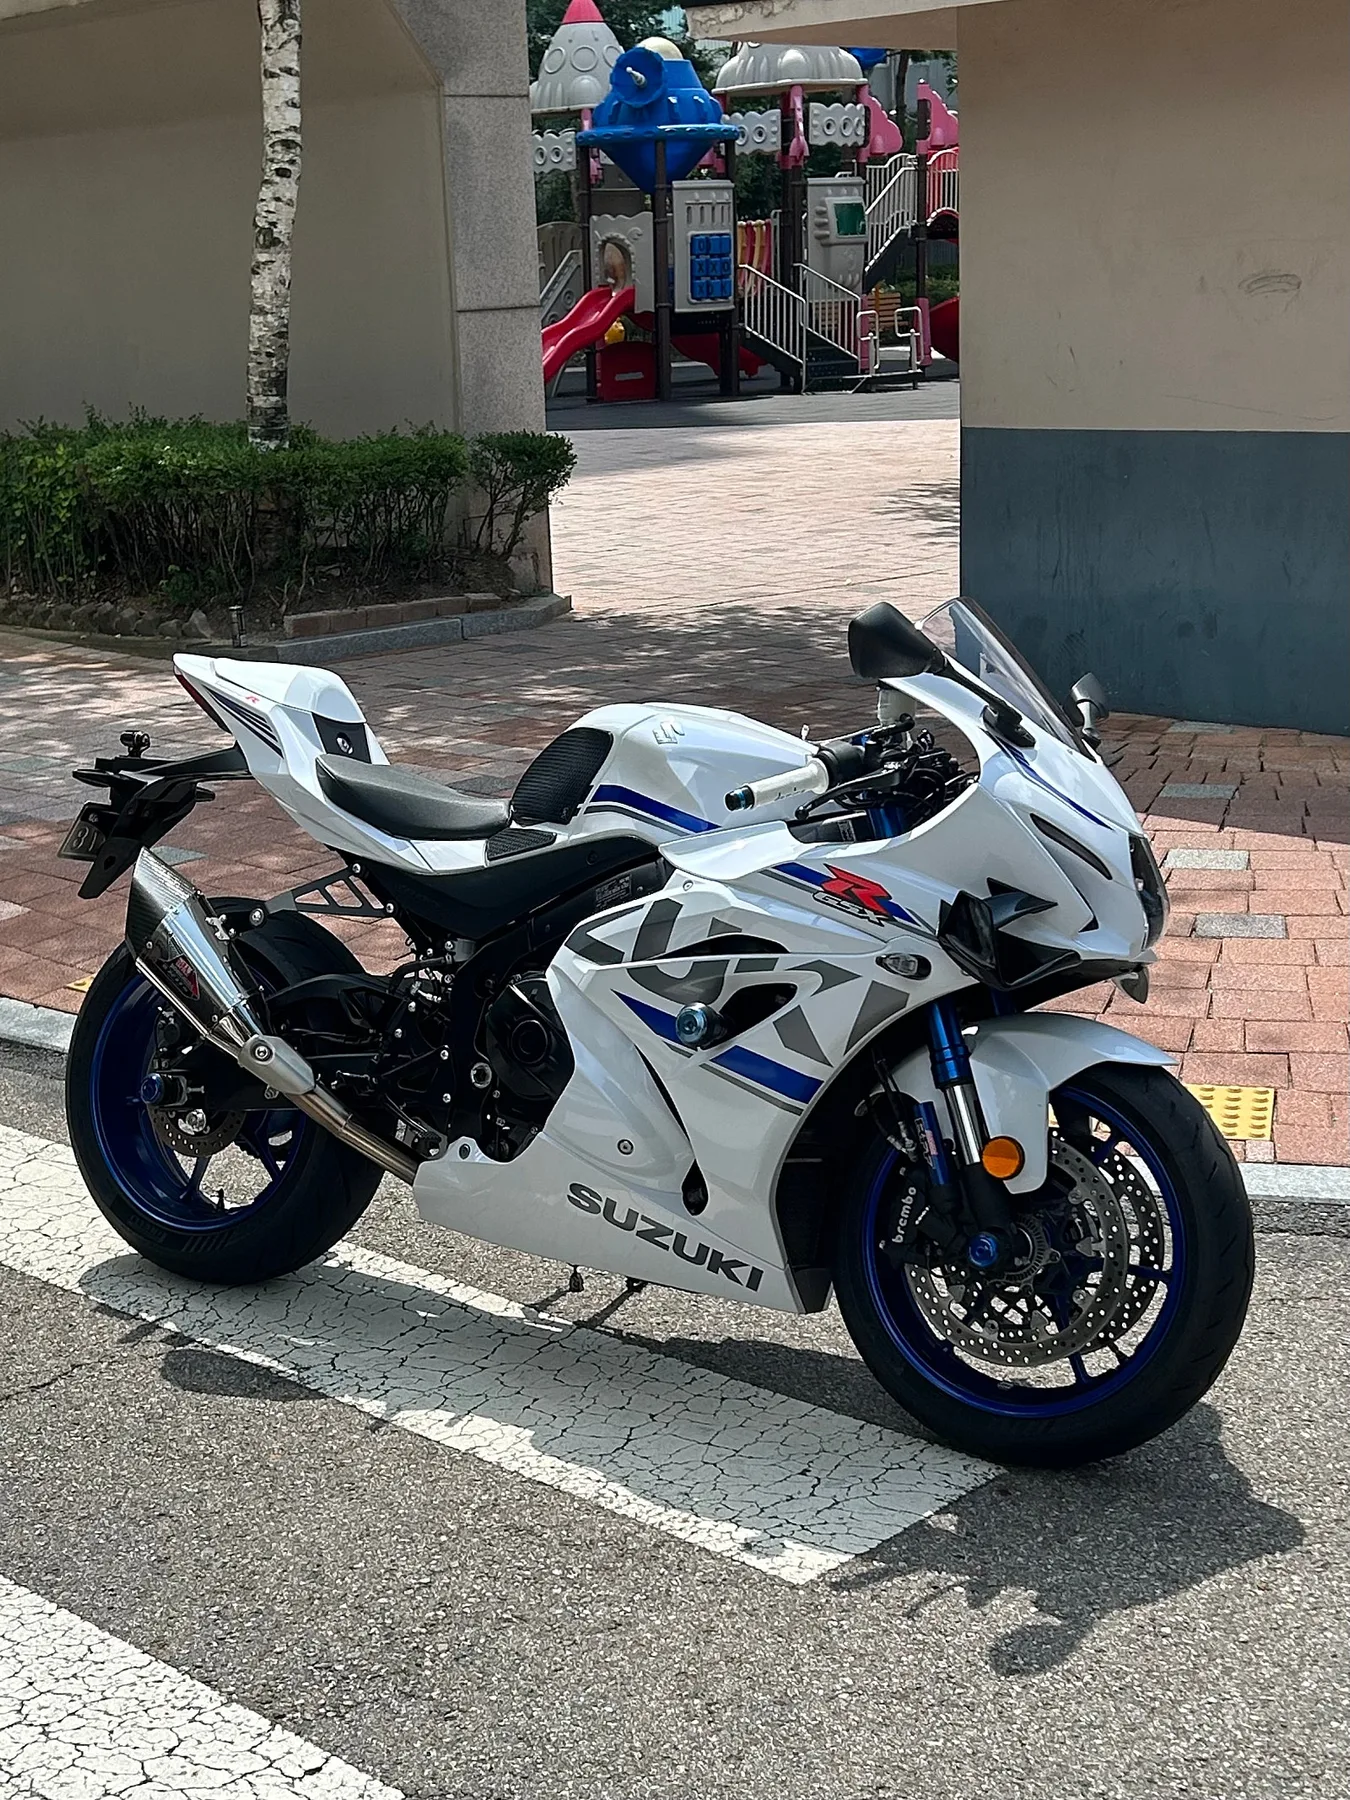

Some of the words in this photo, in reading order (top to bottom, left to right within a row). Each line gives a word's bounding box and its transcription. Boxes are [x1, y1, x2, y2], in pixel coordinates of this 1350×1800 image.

[813, 890, 889, 927] GSX
[820, 862, 893, 918] R
[567, 1182, 764, 1292] SUZUKI
[891, 1186, 917, 1244] brembo
